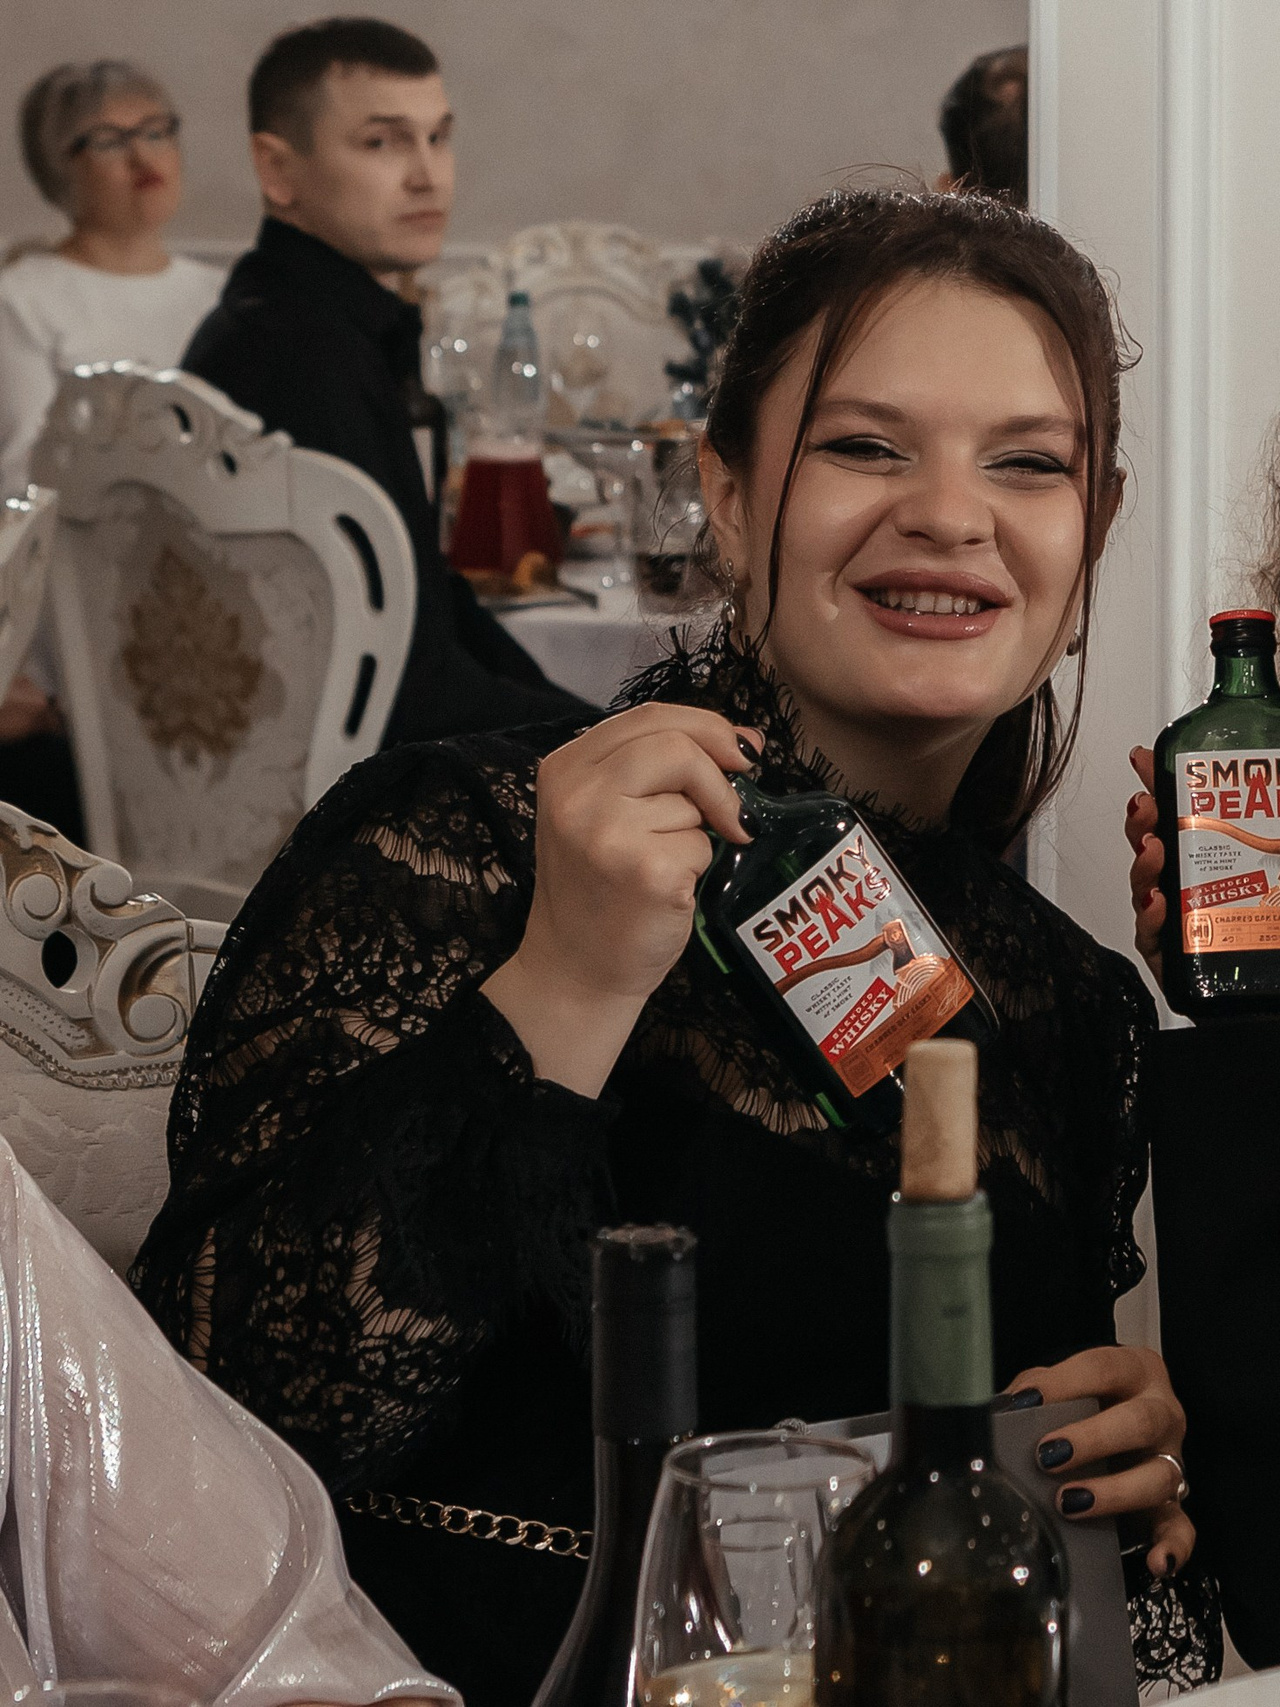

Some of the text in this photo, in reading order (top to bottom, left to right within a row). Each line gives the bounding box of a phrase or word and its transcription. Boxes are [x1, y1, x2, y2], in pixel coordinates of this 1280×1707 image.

[1198, 844, 1231, 852] CLASSIC
[752, 835, 870, 953] SMOKY
[1187, 882, 1264, 909] WHISKY
[773, 867, 892, 976] PEAKS
[1215, 915, 1252, 924] CHARRED
[805, 975, 853, 1013] WHISKY TASTE
[810, 976, 840, 1001] CLASSIC
[814, 1001, 832, 1016] WITH
[835, 985, 852, 1000] HINT
[829, 992, 854, 1012] SMOKE
[828, 987, 890, 1056] WHISKY
[832, 992, 874, 1039] BLENDED
